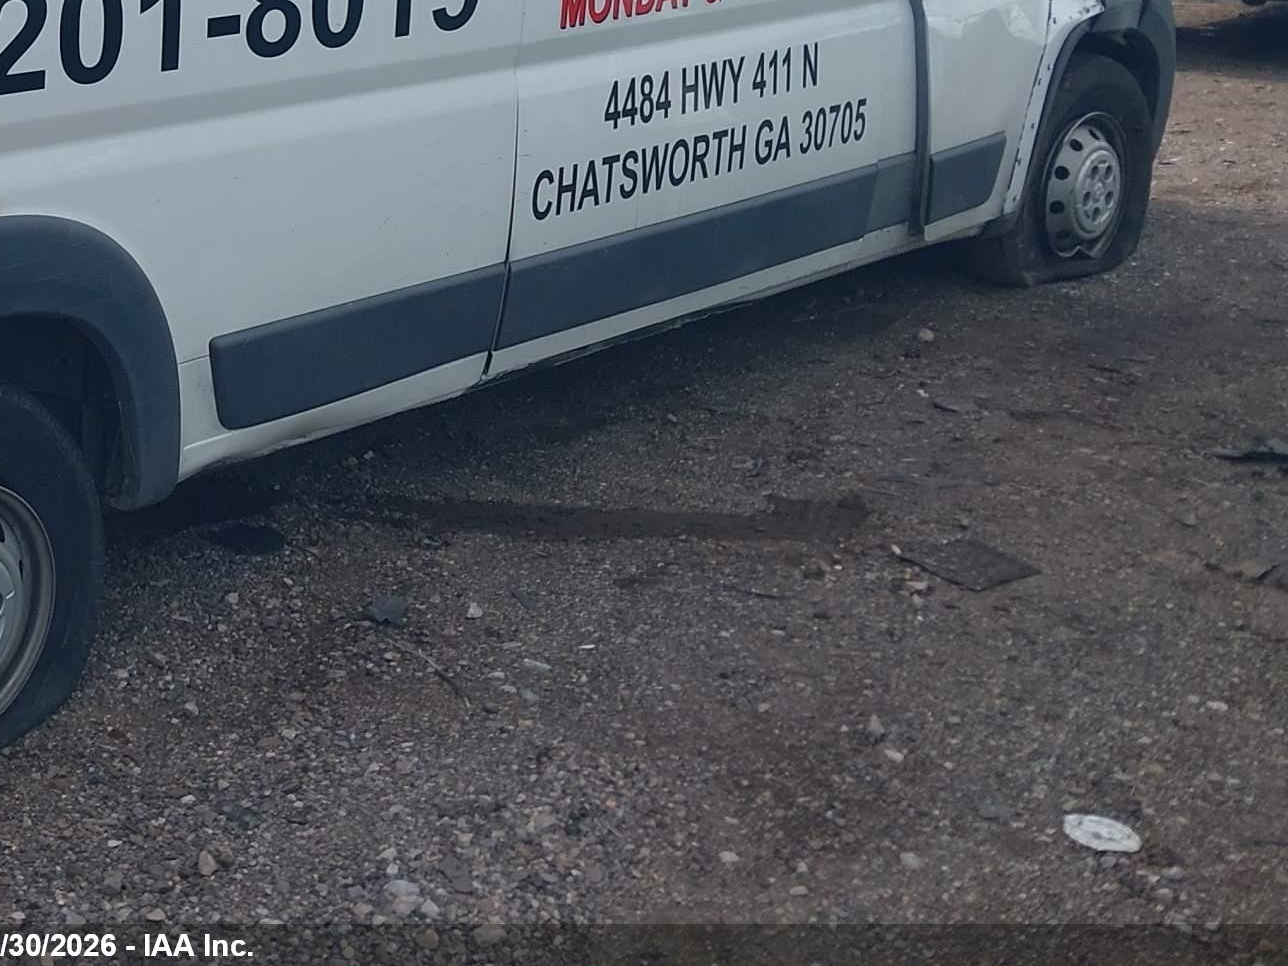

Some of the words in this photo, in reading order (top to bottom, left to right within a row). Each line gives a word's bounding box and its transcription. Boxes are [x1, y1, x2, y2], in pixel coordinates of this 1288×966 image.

[604, 71, 671, 129] 4484
[681, 56, 745, 115] HWY
[752, 47, 791, 98] 411
[803, 42, 819, 89] N
[531, 125, 746, 221] CHATSWORTH
[755, 115, 791, 165] GA
[799, 98, 867, 154] 30705
